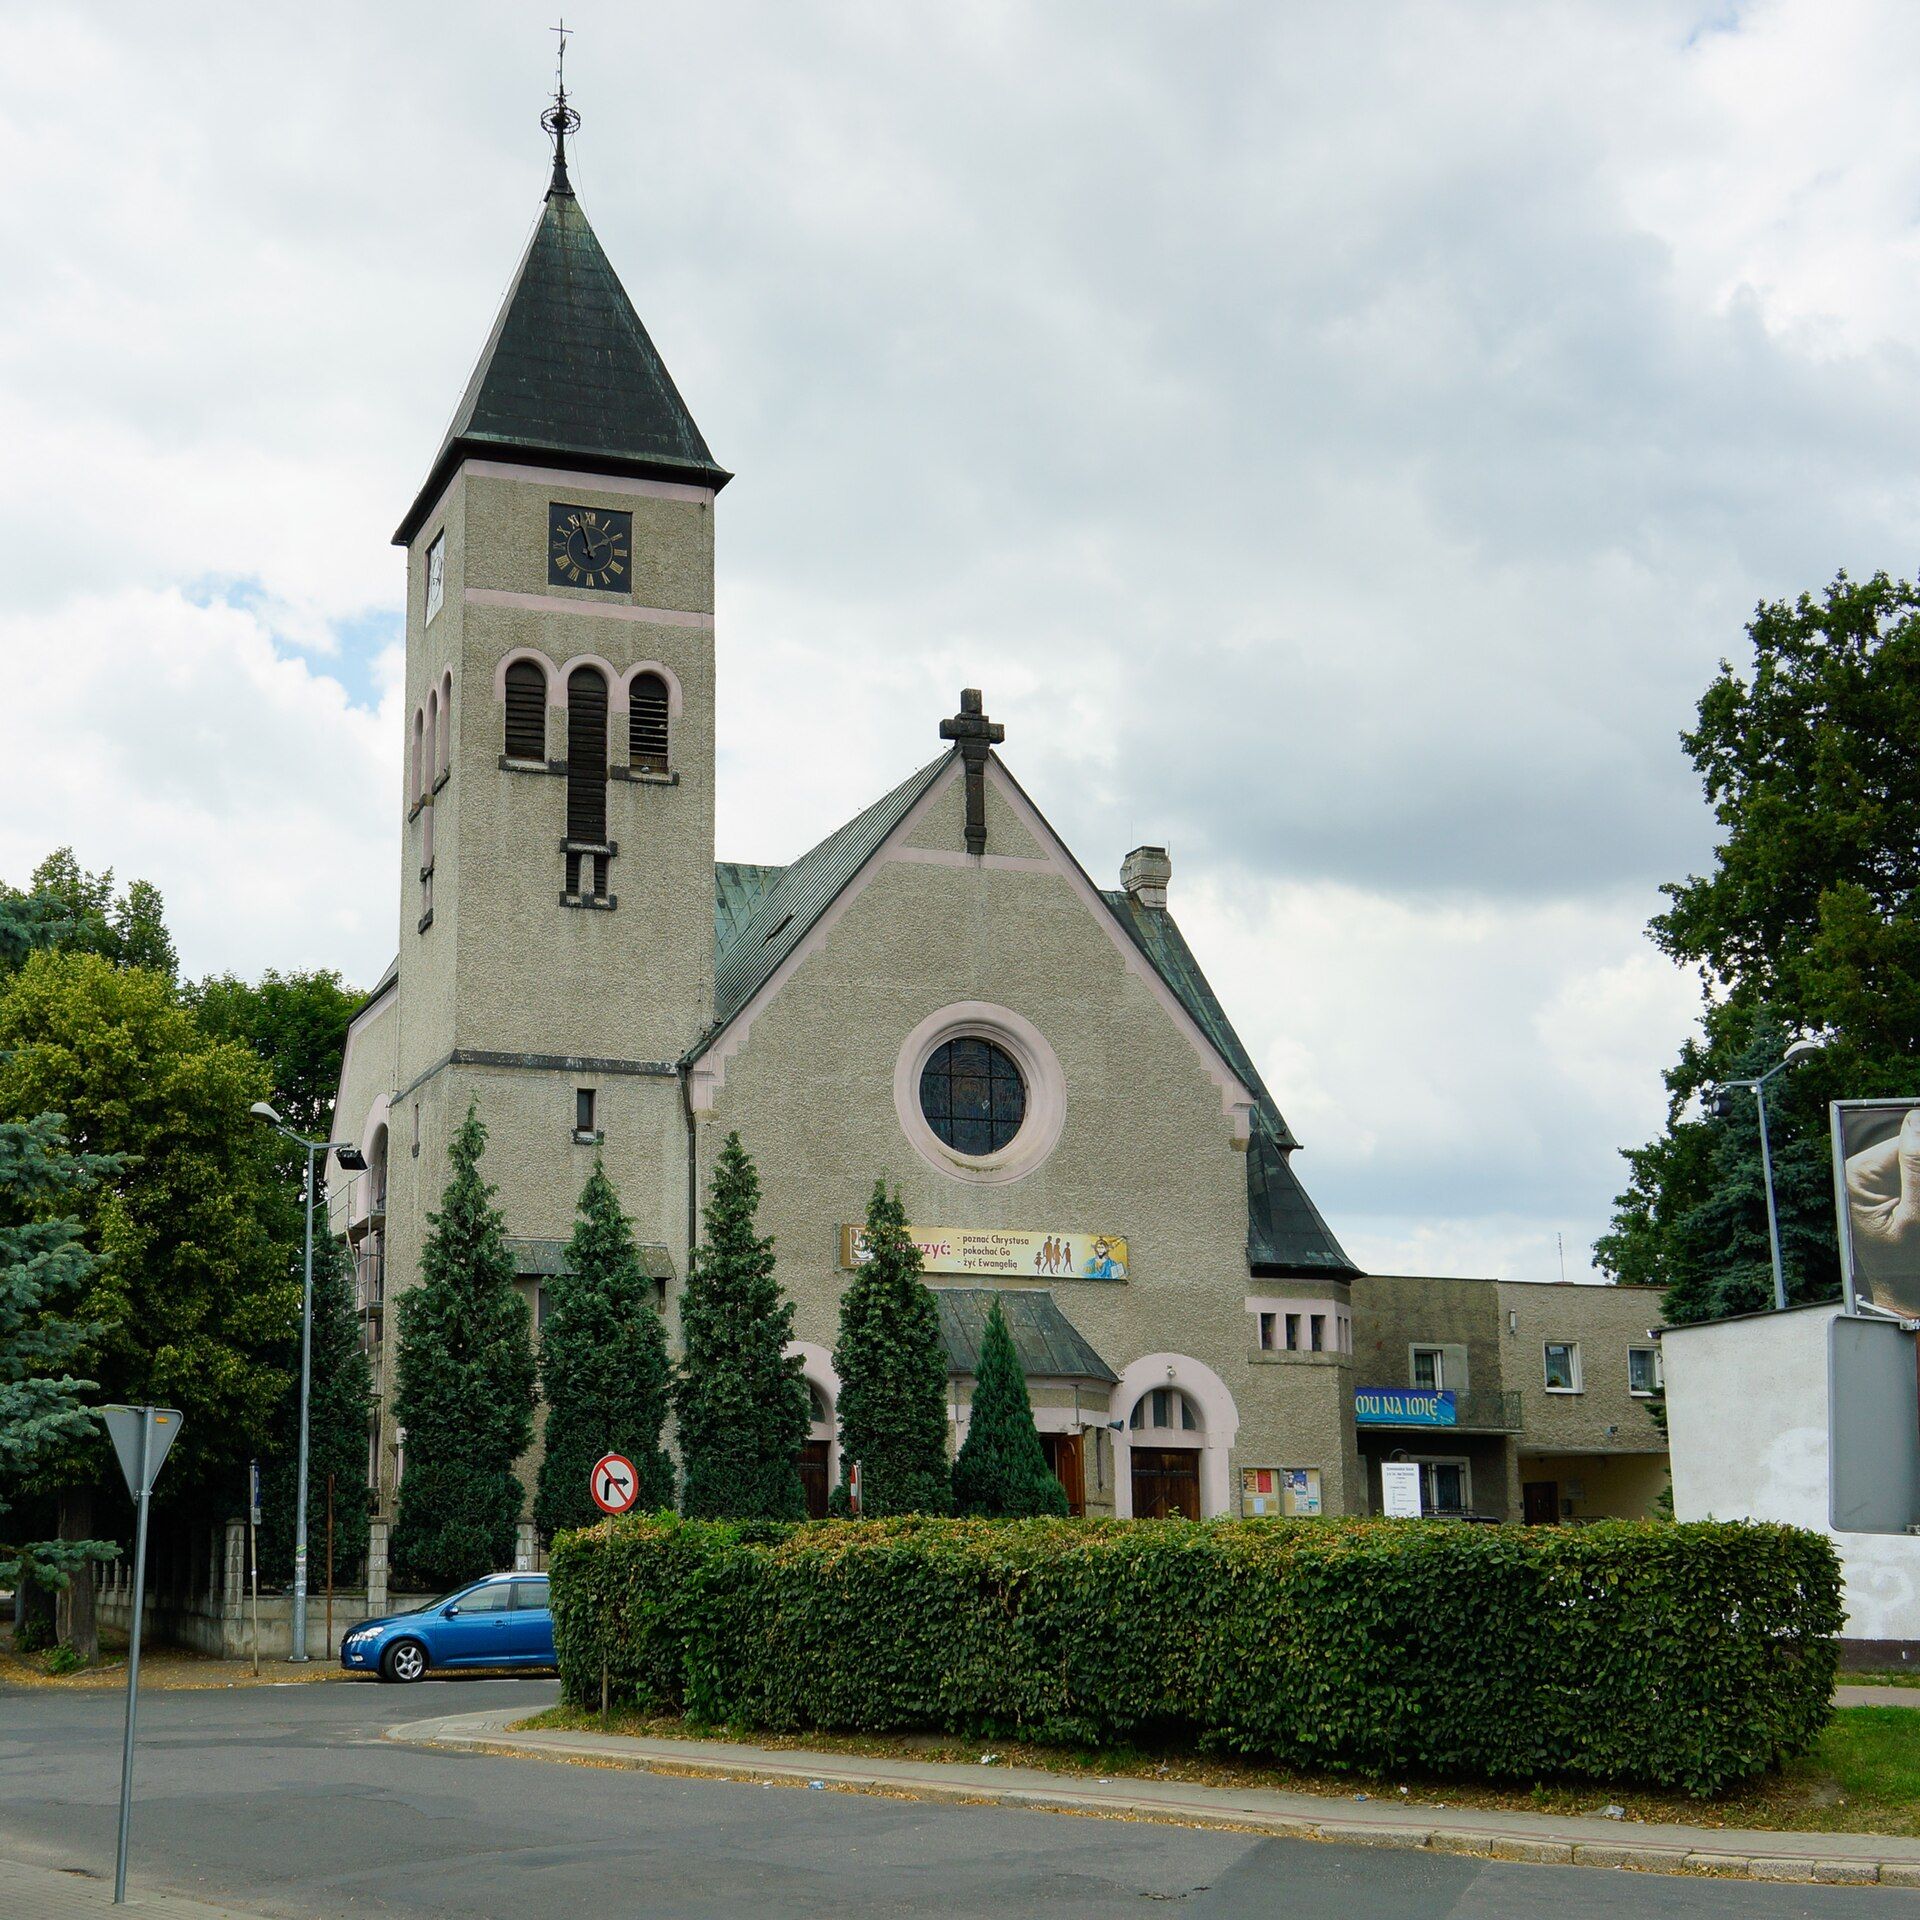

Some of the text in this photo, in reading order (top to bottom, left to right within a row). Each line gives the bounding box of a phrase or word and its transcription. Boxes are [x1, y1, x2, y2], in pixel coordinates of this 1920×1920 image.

[962, 1234, 1030, 1246] poznać Chrystusa
[962, 1245, 1011, 1257] pokochać Go
[978, 1258, 1018, 1271] Ewangelią
